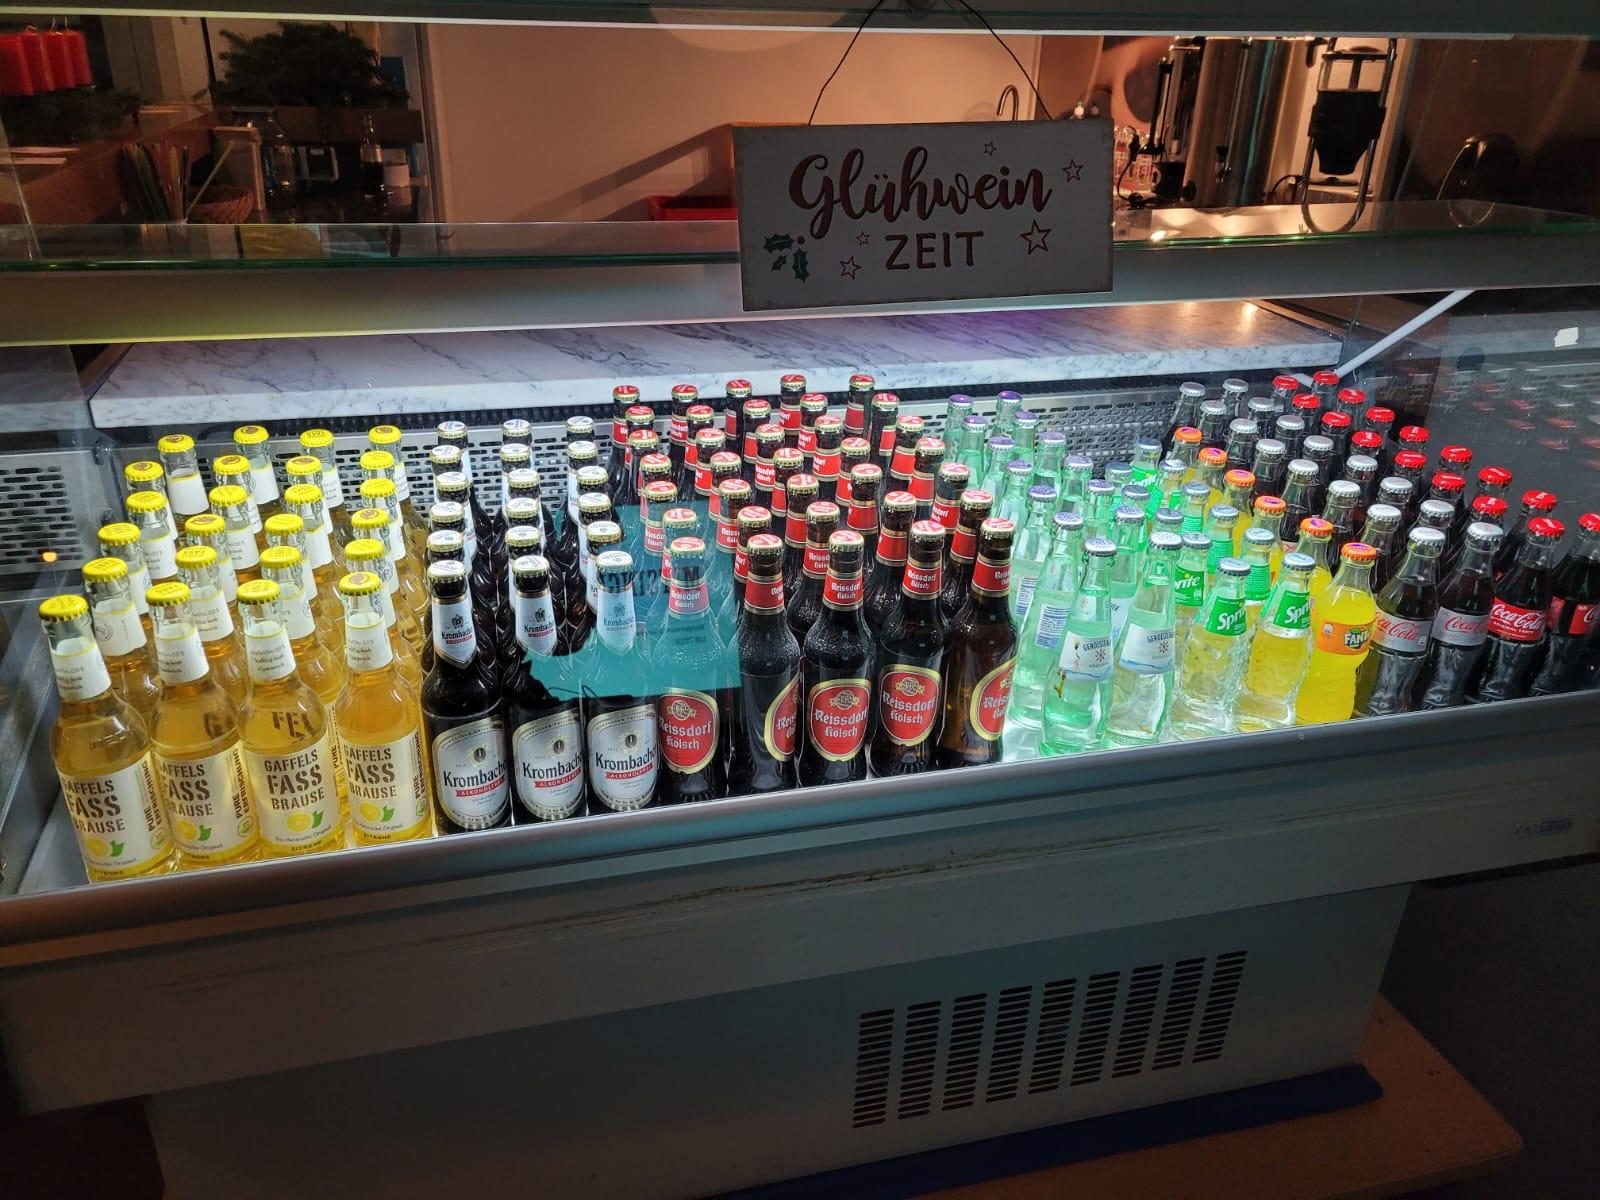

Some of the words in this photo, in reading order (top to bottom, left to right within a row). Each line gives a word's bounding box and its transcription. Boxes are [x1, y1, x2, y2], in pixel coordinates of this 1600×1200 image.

[788, 145, 1053, 240] Glühwein
[884, 230, 984, 271] ZEIT
[1490, 603, 1541, 630] Coca-Cola
[1343, 630, 1370, 646] FANT
[882, 690, 936, 711] Reissdorf
[658, 716, 713, 737] Reissdorf
[814, 707, 869, 726] Reissdorf
[666, 735, 700, 750] Kölsch
[264, 748, 319, 773] GAFFELS
[266, 763, 323, 796] FASS
[346, 762, 395, 785] FASS
[271, 786, 326, 811] BRAUSE
[350, 785, 397, 799] BRAUSE
[143, 805, 156, 832] PURE
[232, 793, 243, 819] PURE
